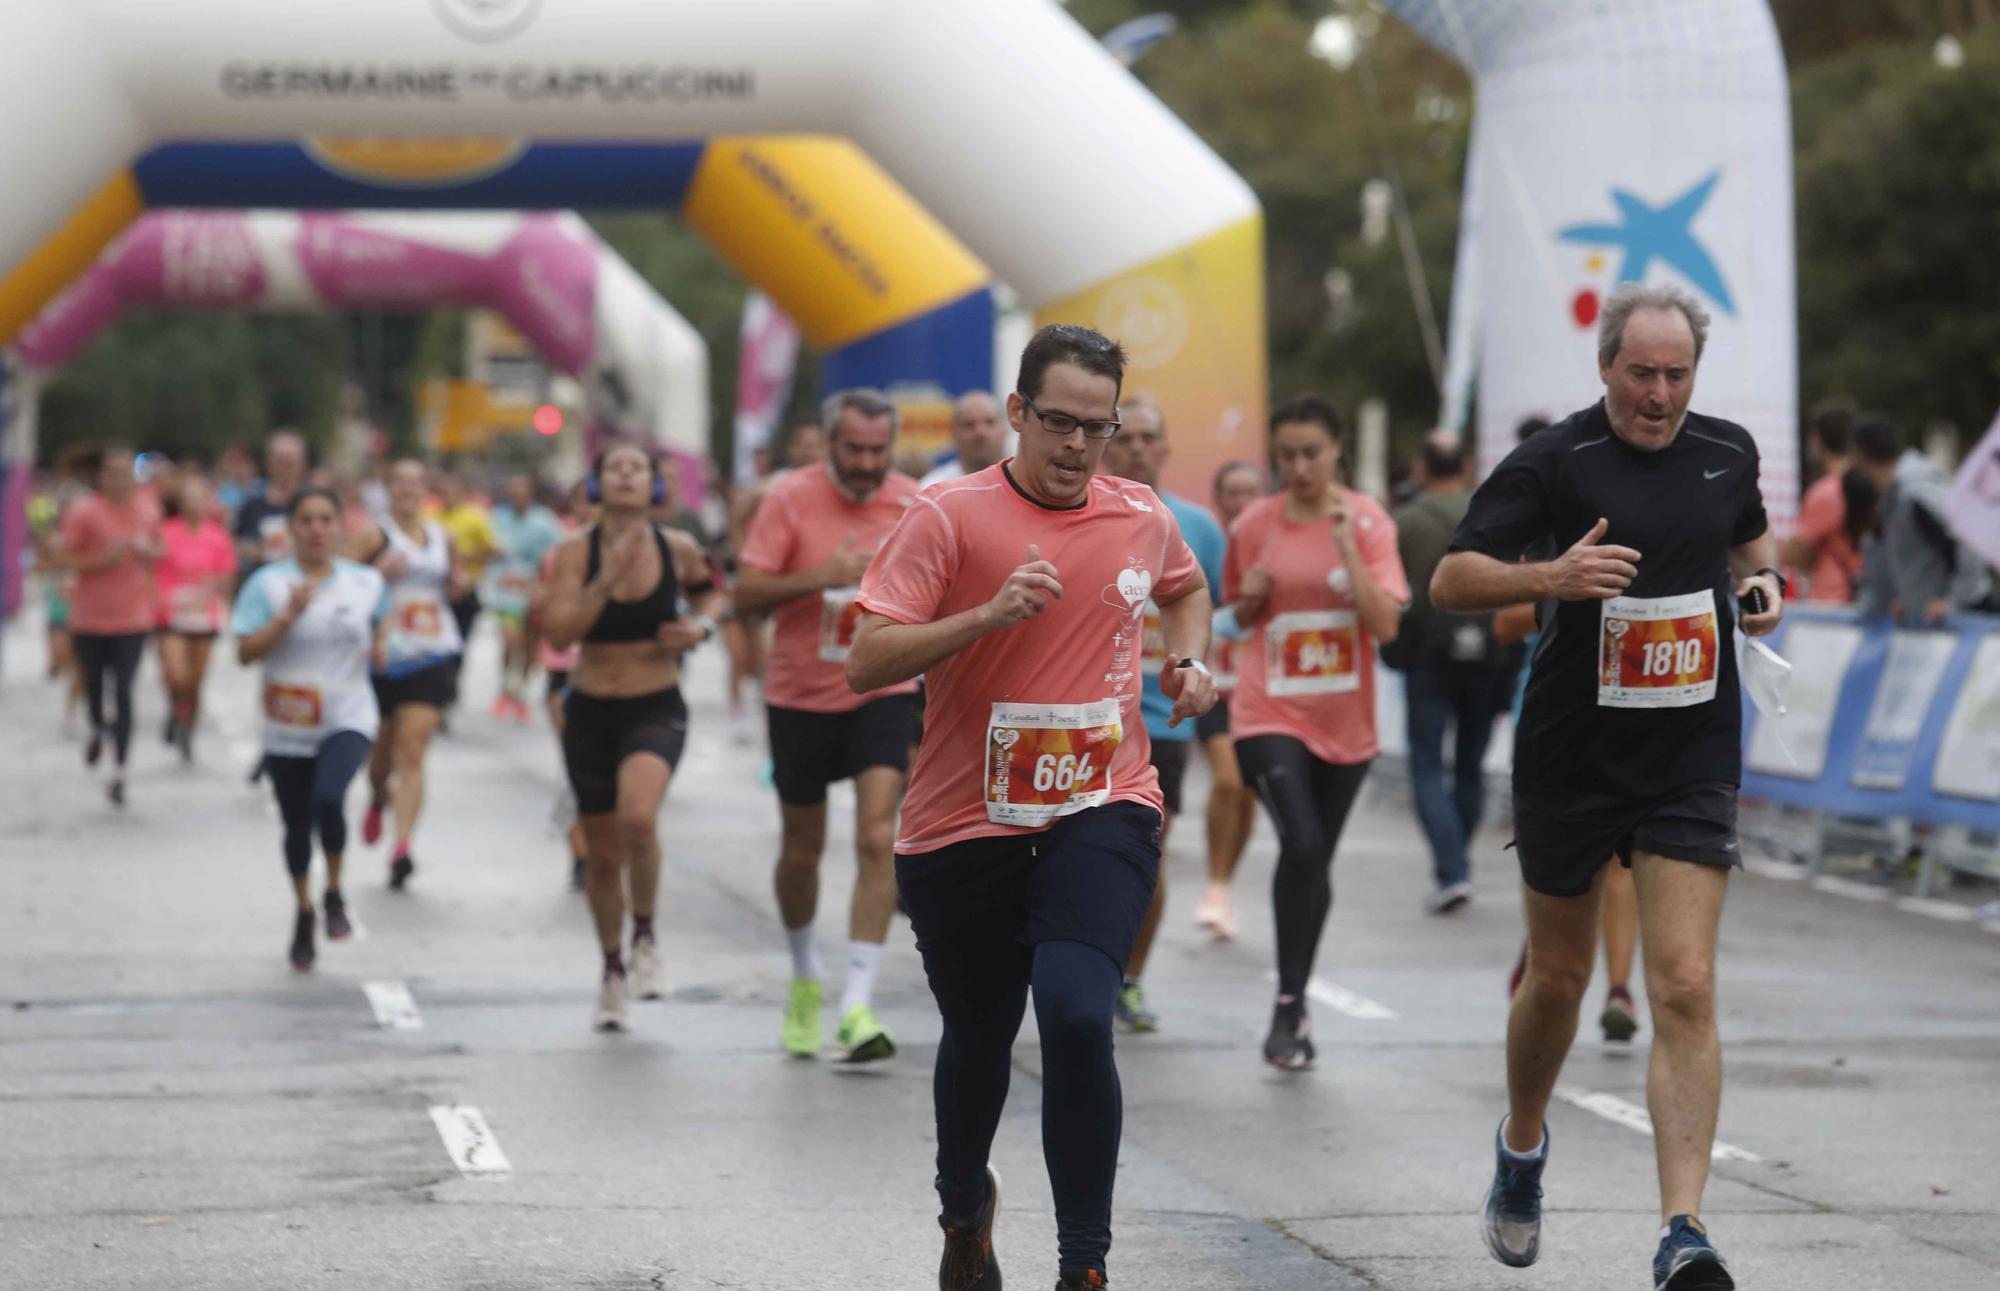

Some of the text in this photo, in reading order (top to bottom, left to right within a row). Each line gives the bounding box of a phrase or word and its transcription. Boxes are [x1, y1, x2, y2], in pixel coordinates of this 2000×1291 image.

[223, 64, 458, 101] GERMAINE
[507, 65, 757, 102] CAPUCCINI
[1642, 638, 1701, 677] 1810
[1033, 752, 1094, 792] 664
